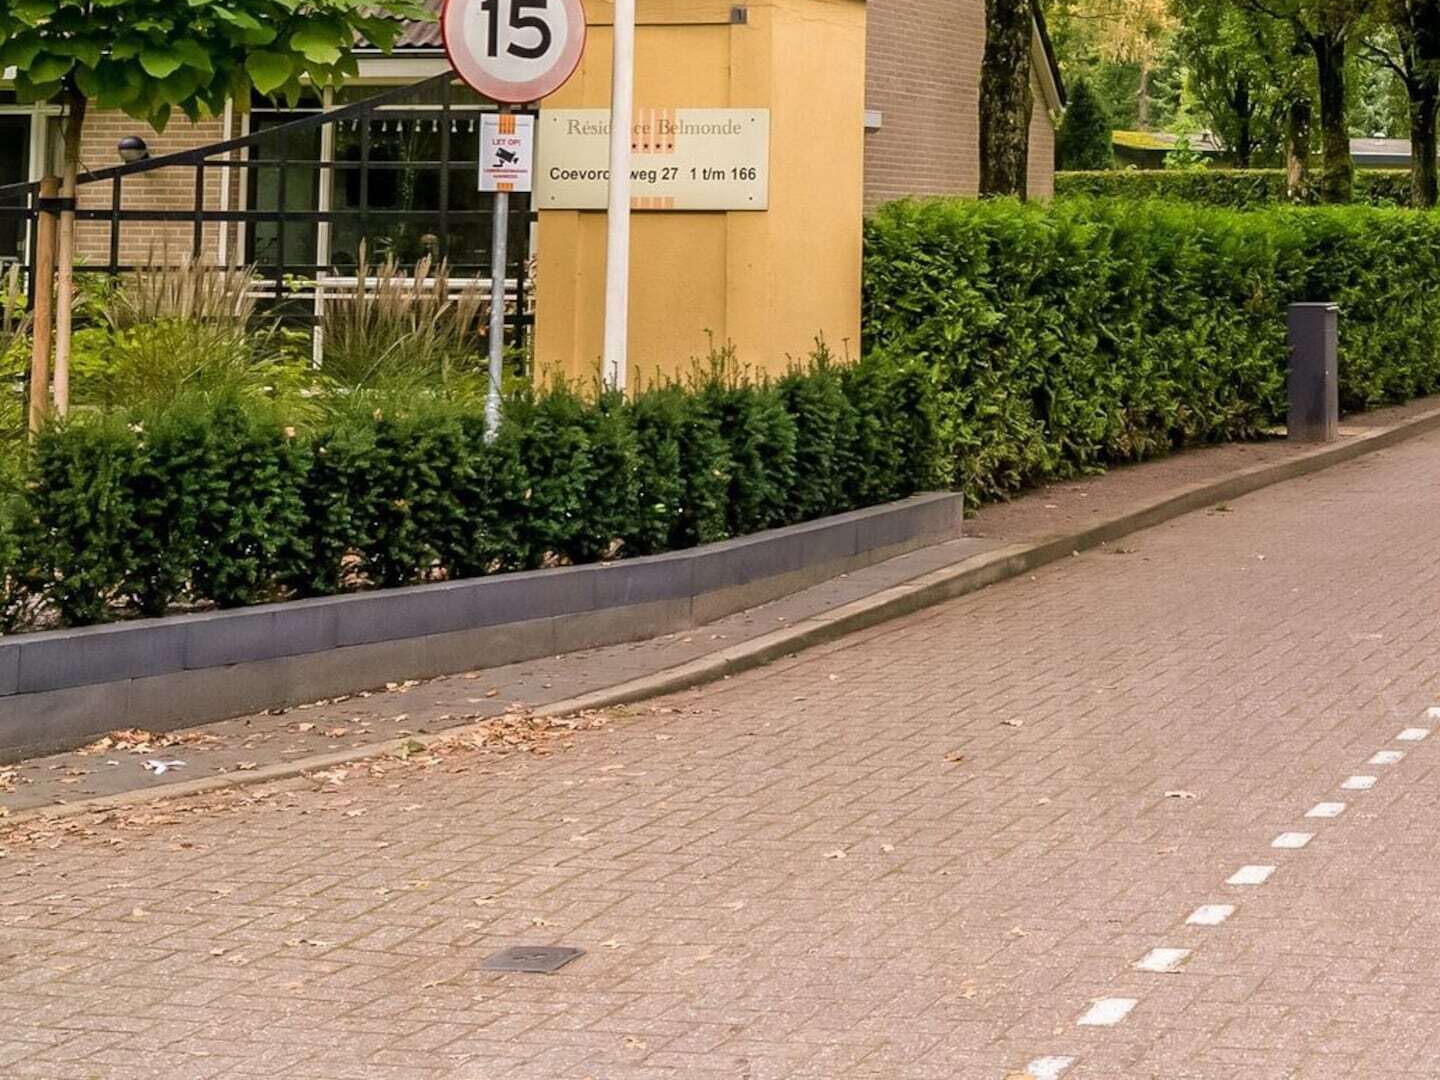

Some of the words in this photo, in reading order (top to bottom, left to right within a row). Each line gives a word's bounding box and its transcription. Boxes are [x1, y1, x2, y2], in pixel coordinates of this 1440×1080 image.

[658, 118, 742, 135] Belmonde
[661, 167, 679, 181] 27
[690, 167, 697, 181] 1
[702, 167, 725, 181] t/m
[731, 167, 757, 181] 166
